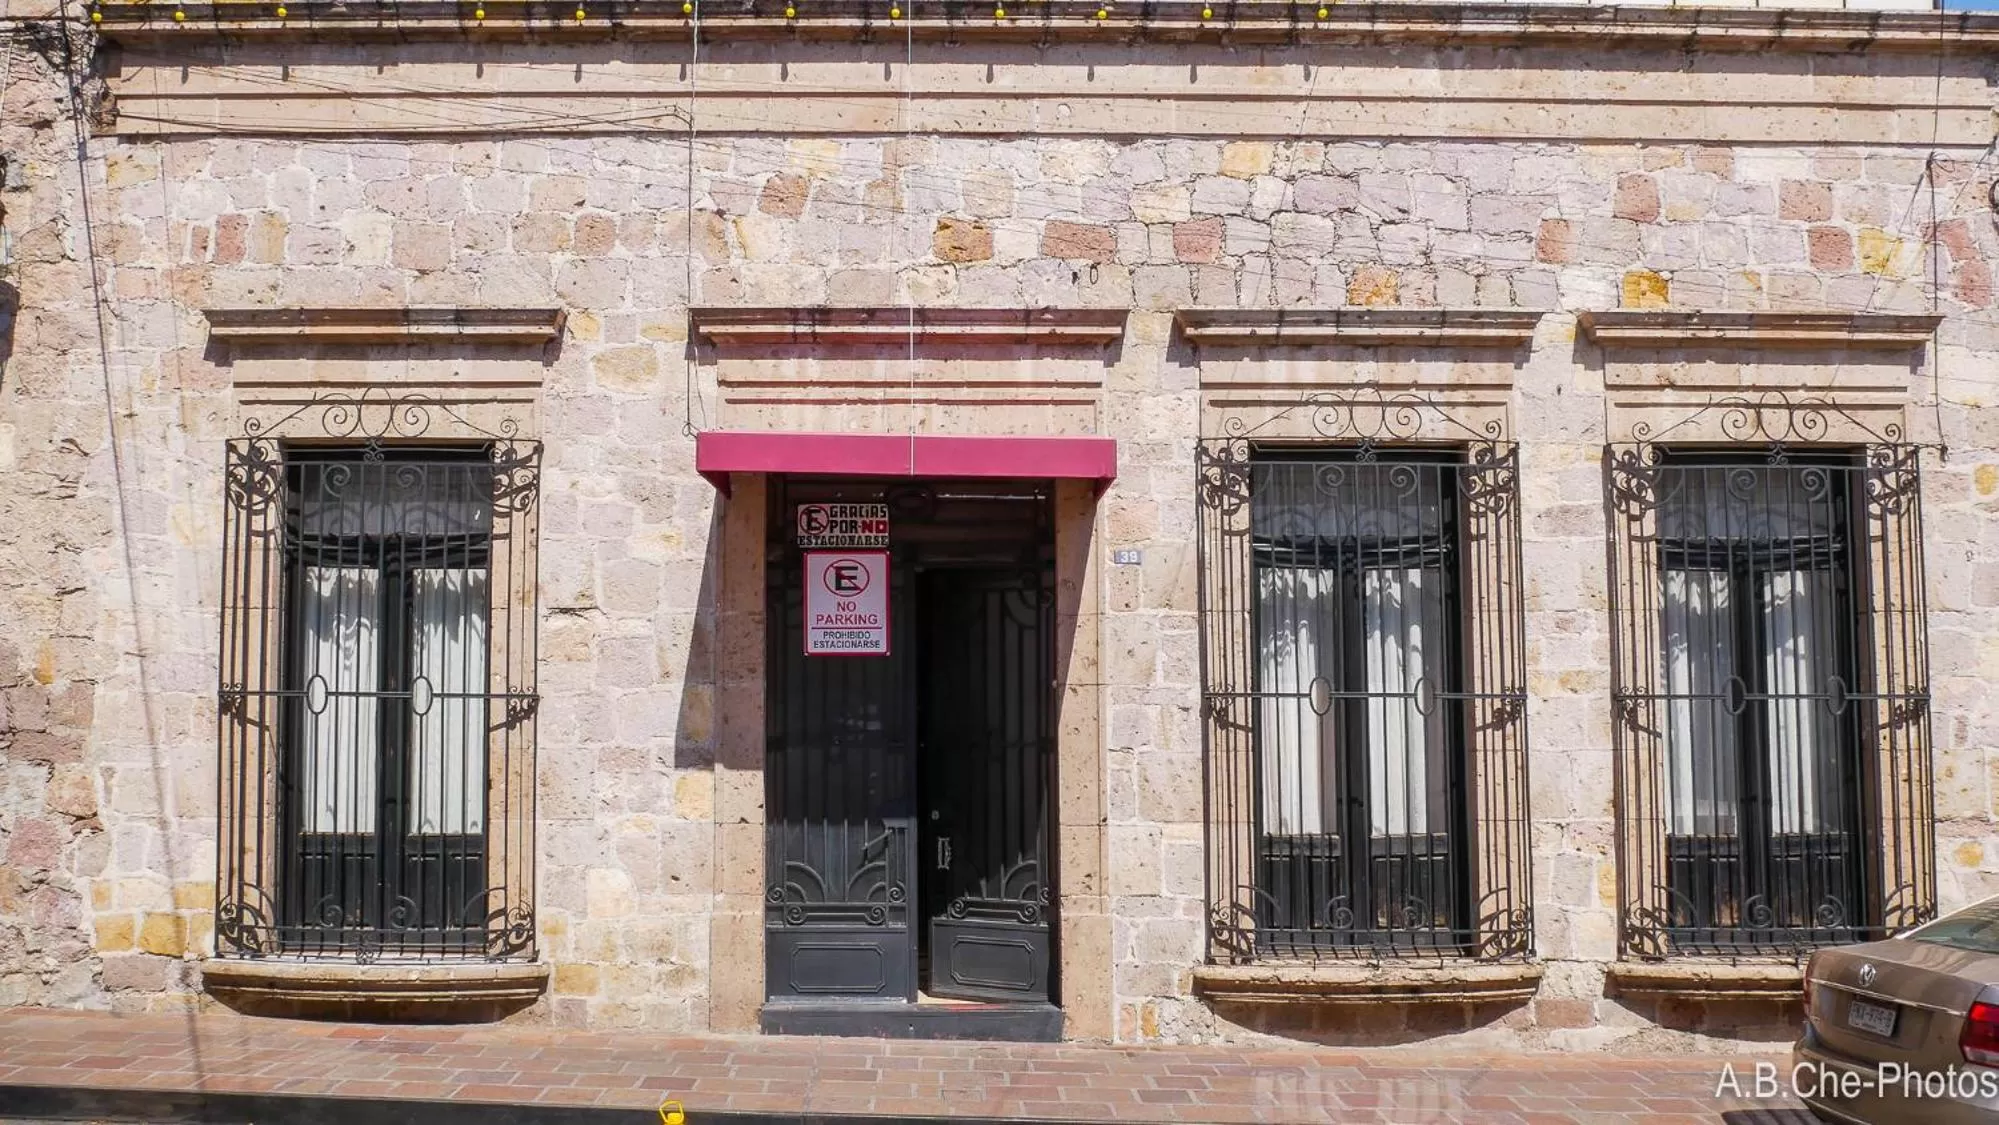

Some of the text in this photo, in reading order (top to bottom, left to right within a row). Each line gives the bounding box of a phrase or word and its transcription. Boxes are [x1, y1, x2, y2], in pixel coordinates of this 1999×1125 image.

[837, 601, 856, 612] NO
[816, 615, 878, 625] PARKING
[823, 631, 871, 640] PROHIBIDO
[813, 640, 880, 649] ESTACIONARSE
